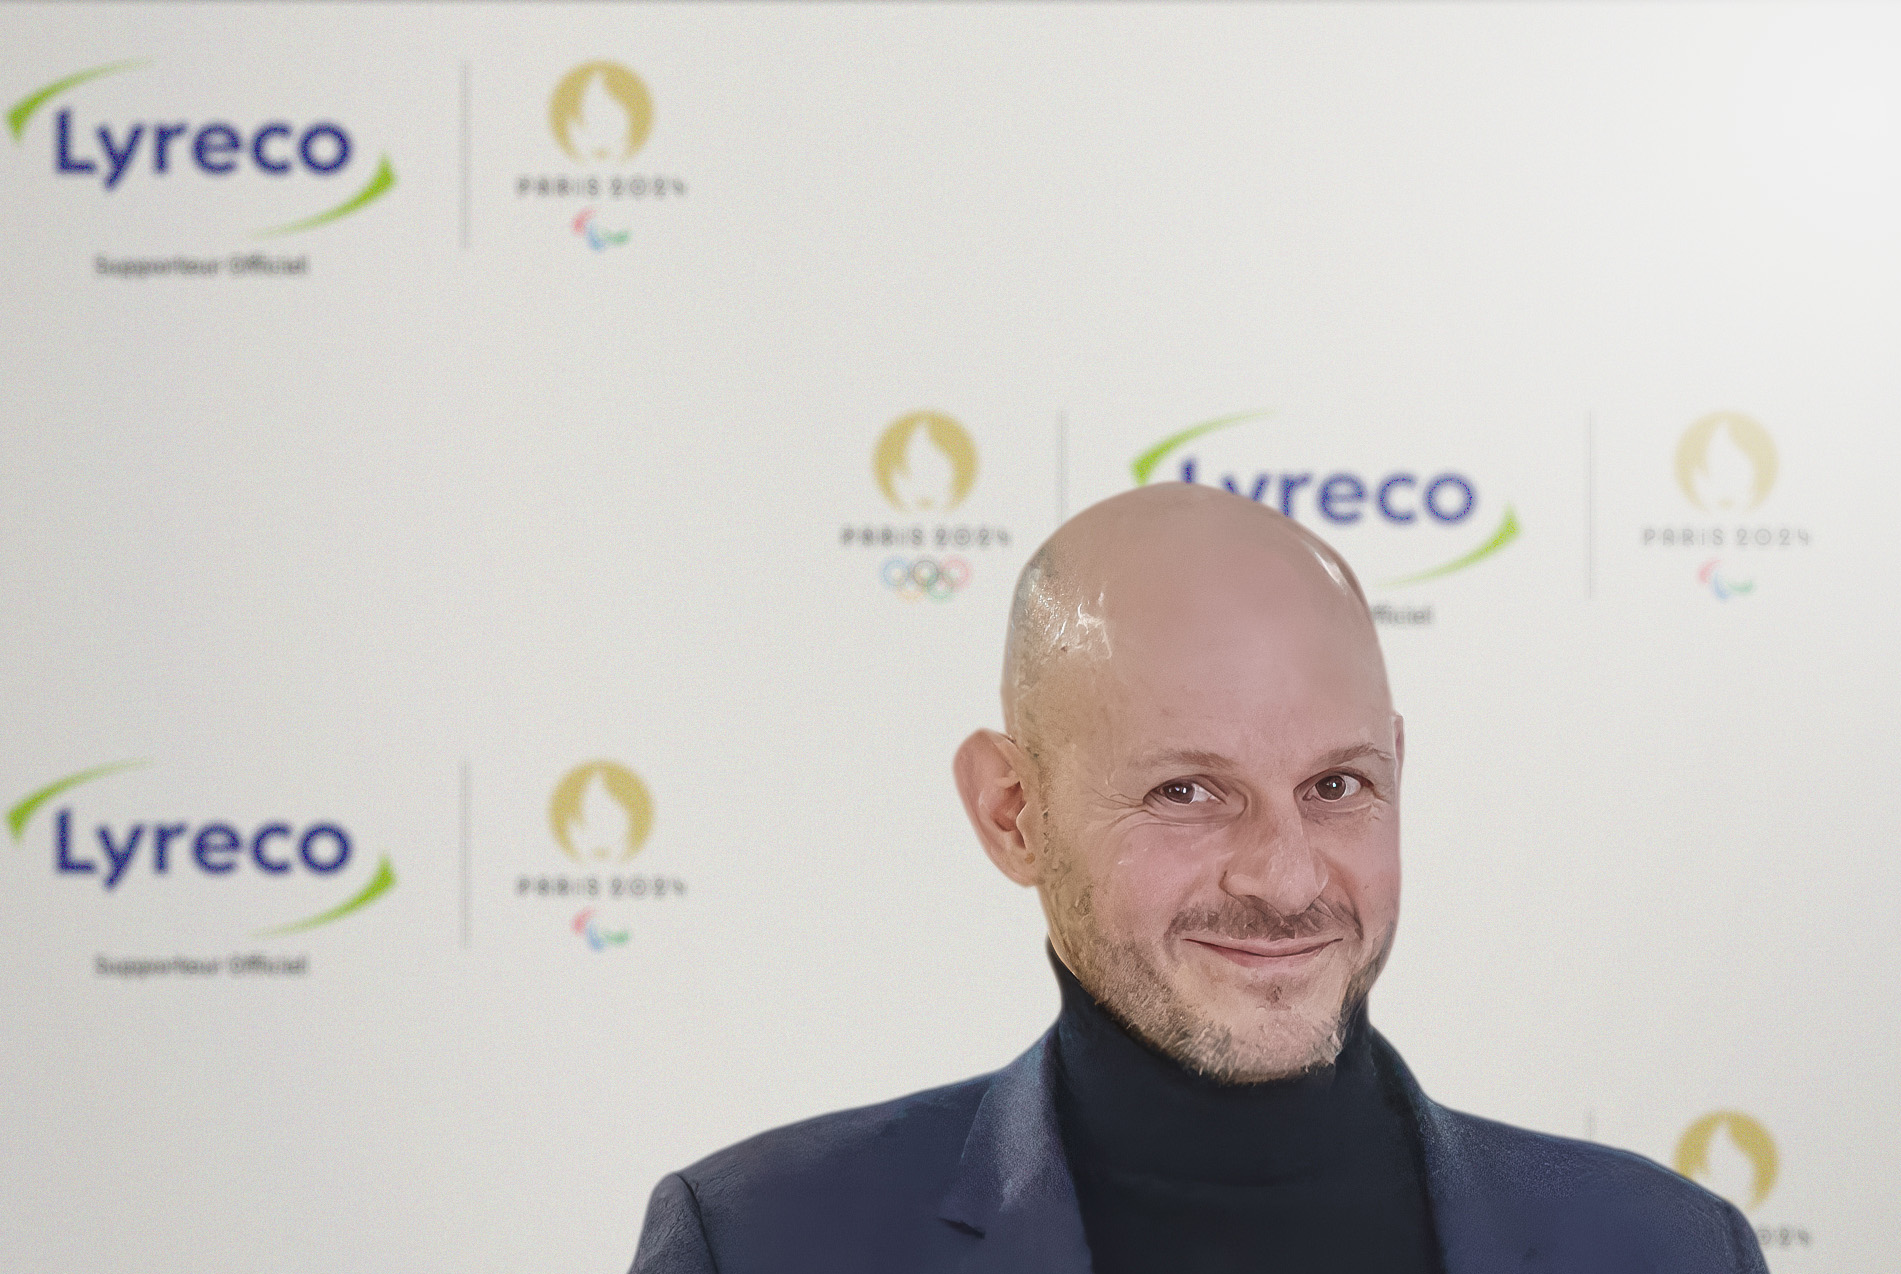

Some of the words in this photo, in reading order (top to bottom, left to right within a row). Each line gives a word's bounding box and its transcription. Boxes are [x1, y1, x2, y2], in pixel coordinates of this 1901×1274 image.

[54, 107, 354, 191] Lyreco
[609, 175, 689, 199] 2024
[933, 525, 1013, 549] 2024
[1734, 525, 1814, 549] 2024
[54, 807, 354, 891] Lyreco
[609, 875, 689, 899] 2024
[1757, 1225, 1814, 1249] 024
